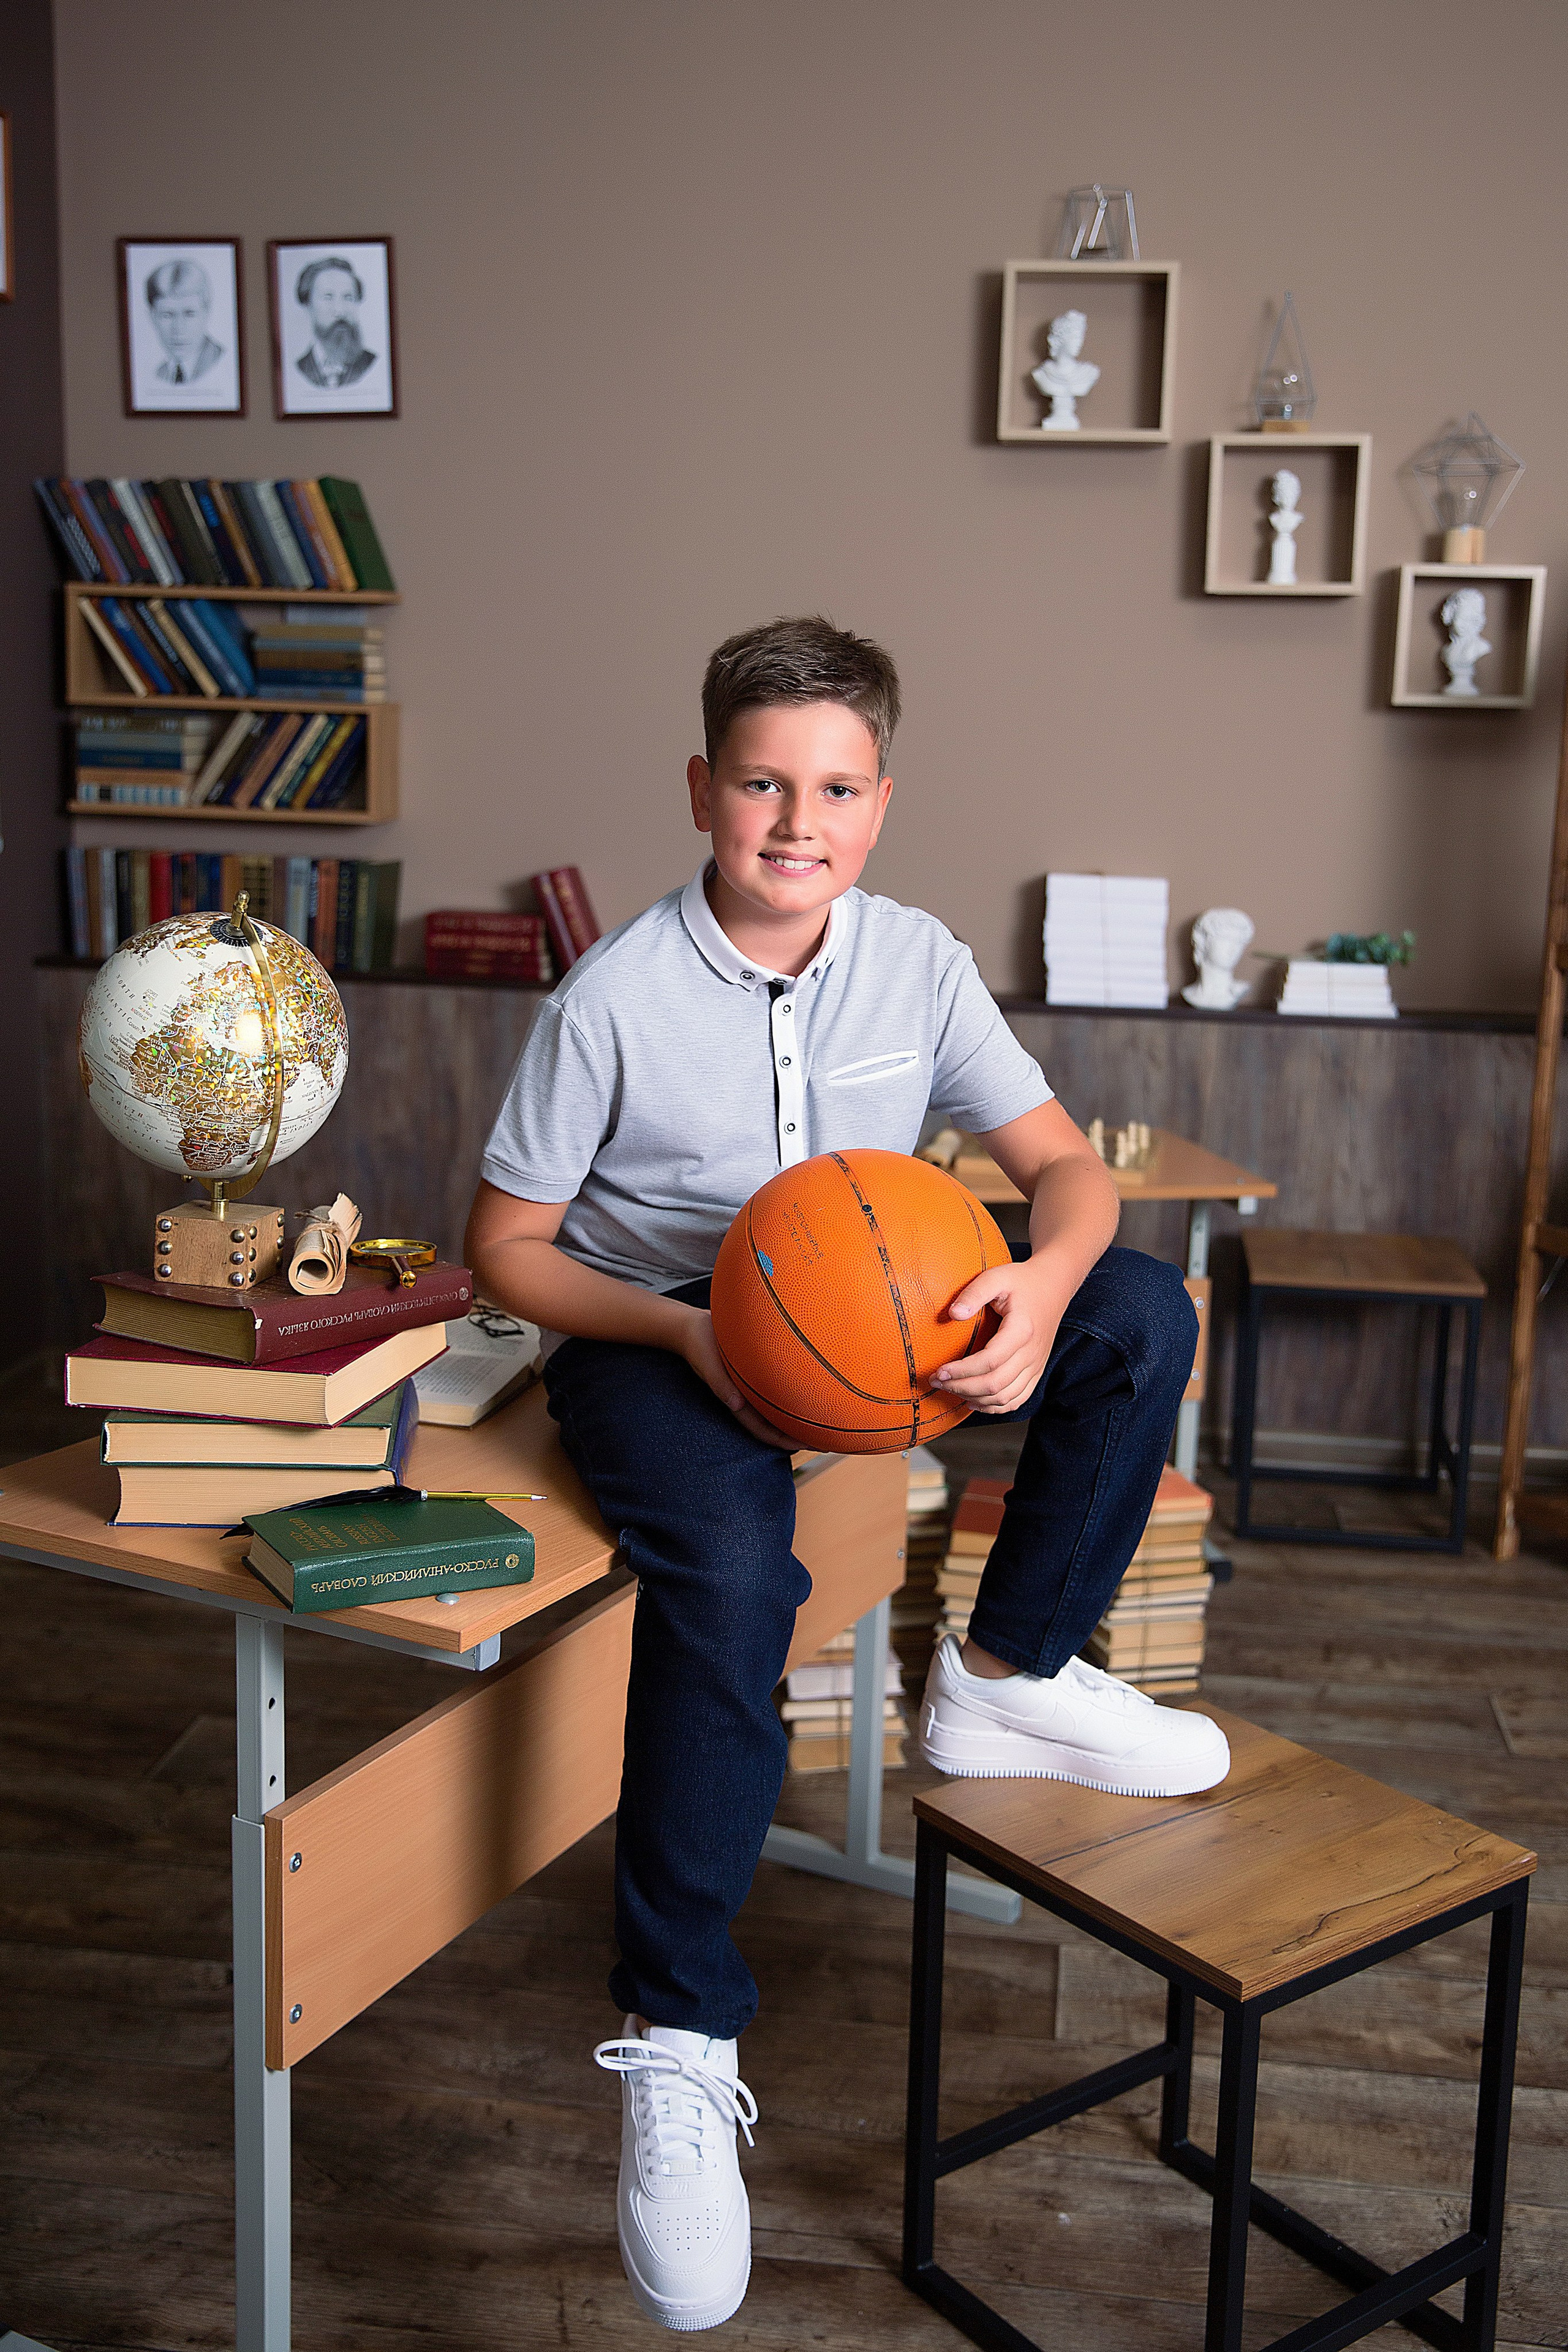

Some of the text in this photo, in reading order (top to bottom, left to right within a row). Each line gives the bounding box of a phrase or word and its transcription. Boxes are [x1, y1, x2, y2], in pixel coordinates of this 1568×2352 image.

[116, 974, 135, 1000] NORTH
[169, 1040, 186, 1049] ALGERIA
[182, 1070, 197, 1079] NIGER
[111, 1096, 143, 1118] SOUTH
[310, 1311, 353, 1330] РУССКОГО
[353, 1304, 390, 1320] СЛОВАРЬ
[278, 1322, 309, 1336] ЯЗЫКА
[311, 1557, 500, 1593] РУССКО-АНГЛИЙСКИЙ СЛОВАРЬ
